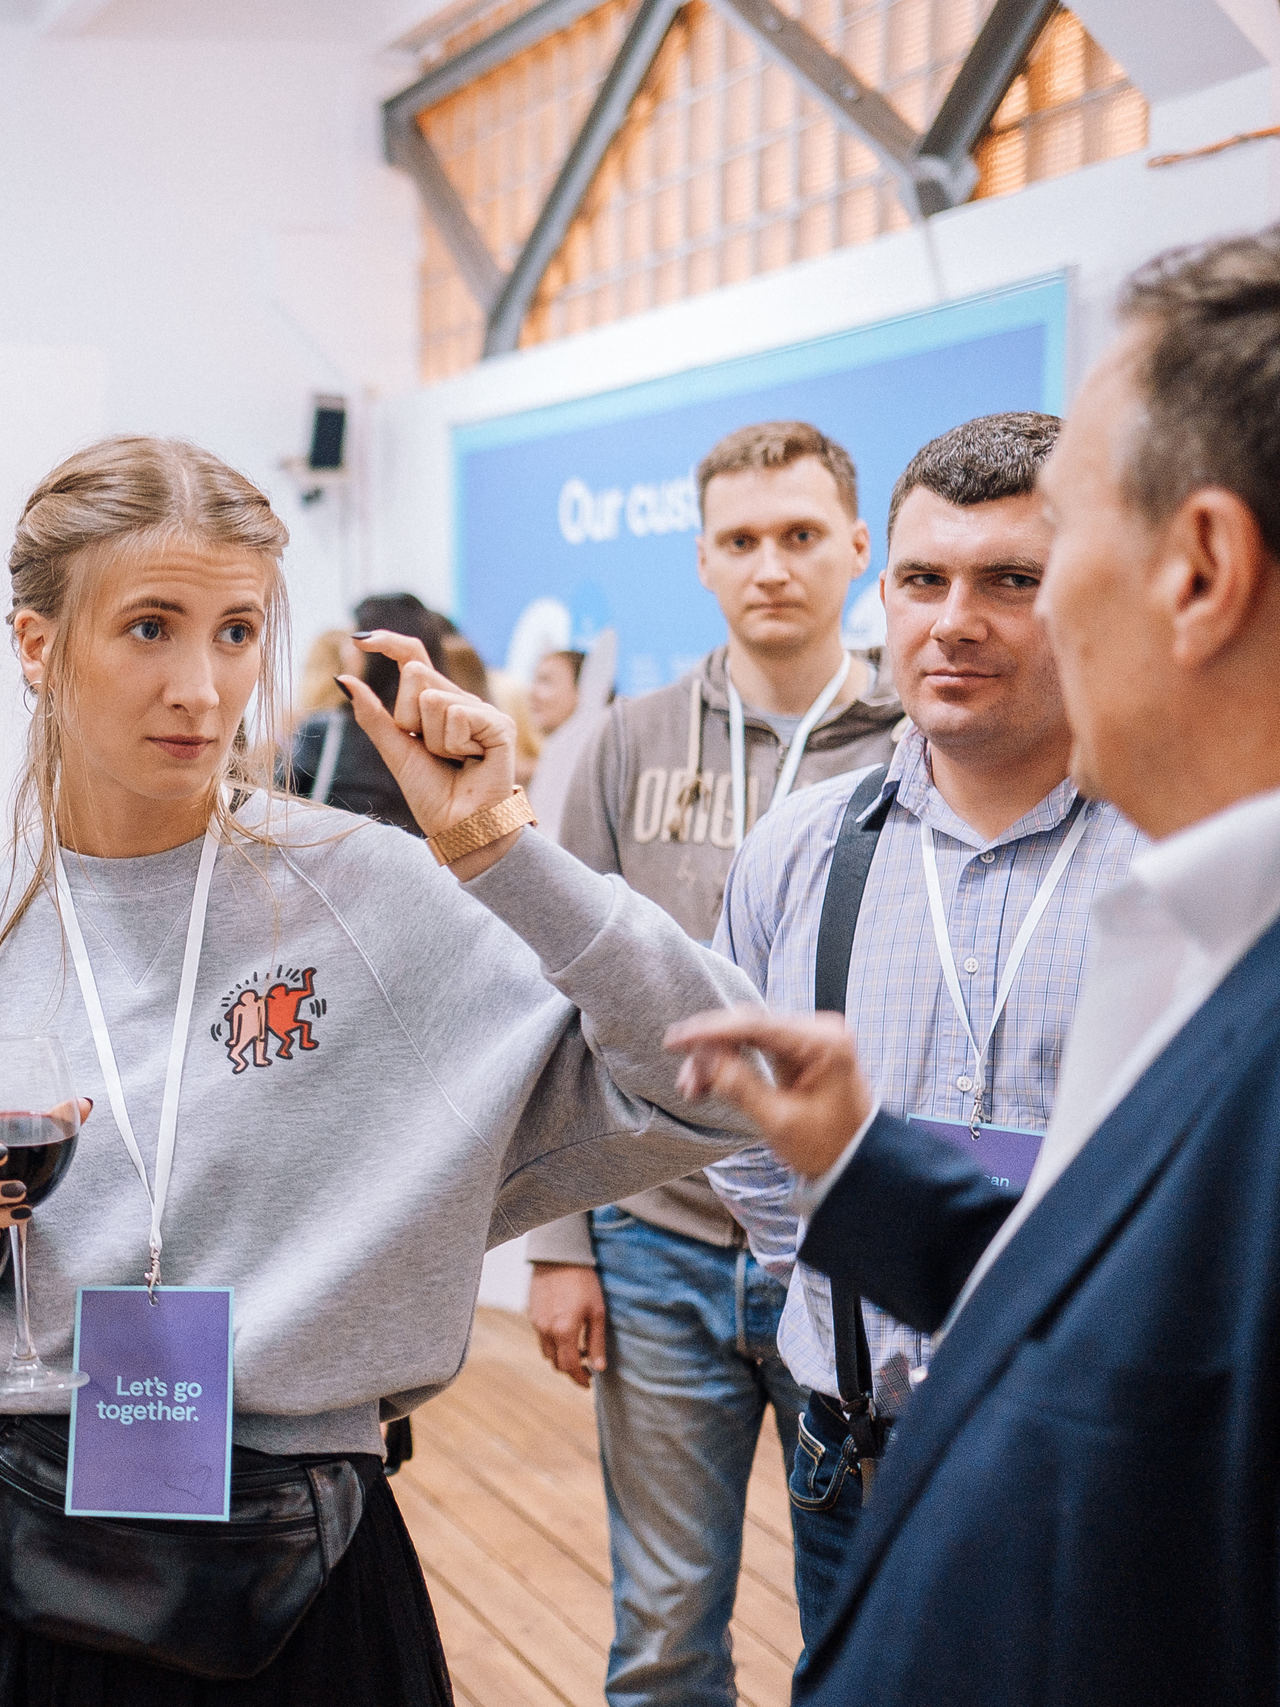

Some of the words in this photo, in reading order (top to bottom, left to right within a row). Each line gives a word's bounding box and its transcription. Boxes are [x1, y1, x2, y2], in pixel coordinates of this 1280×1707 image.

[558, 475, 623, 544] Our
[116, 1375, 168, 1398] Let's
[173, 1381, 203, 1402] go
[96, 1400, 199, 1425] together.
